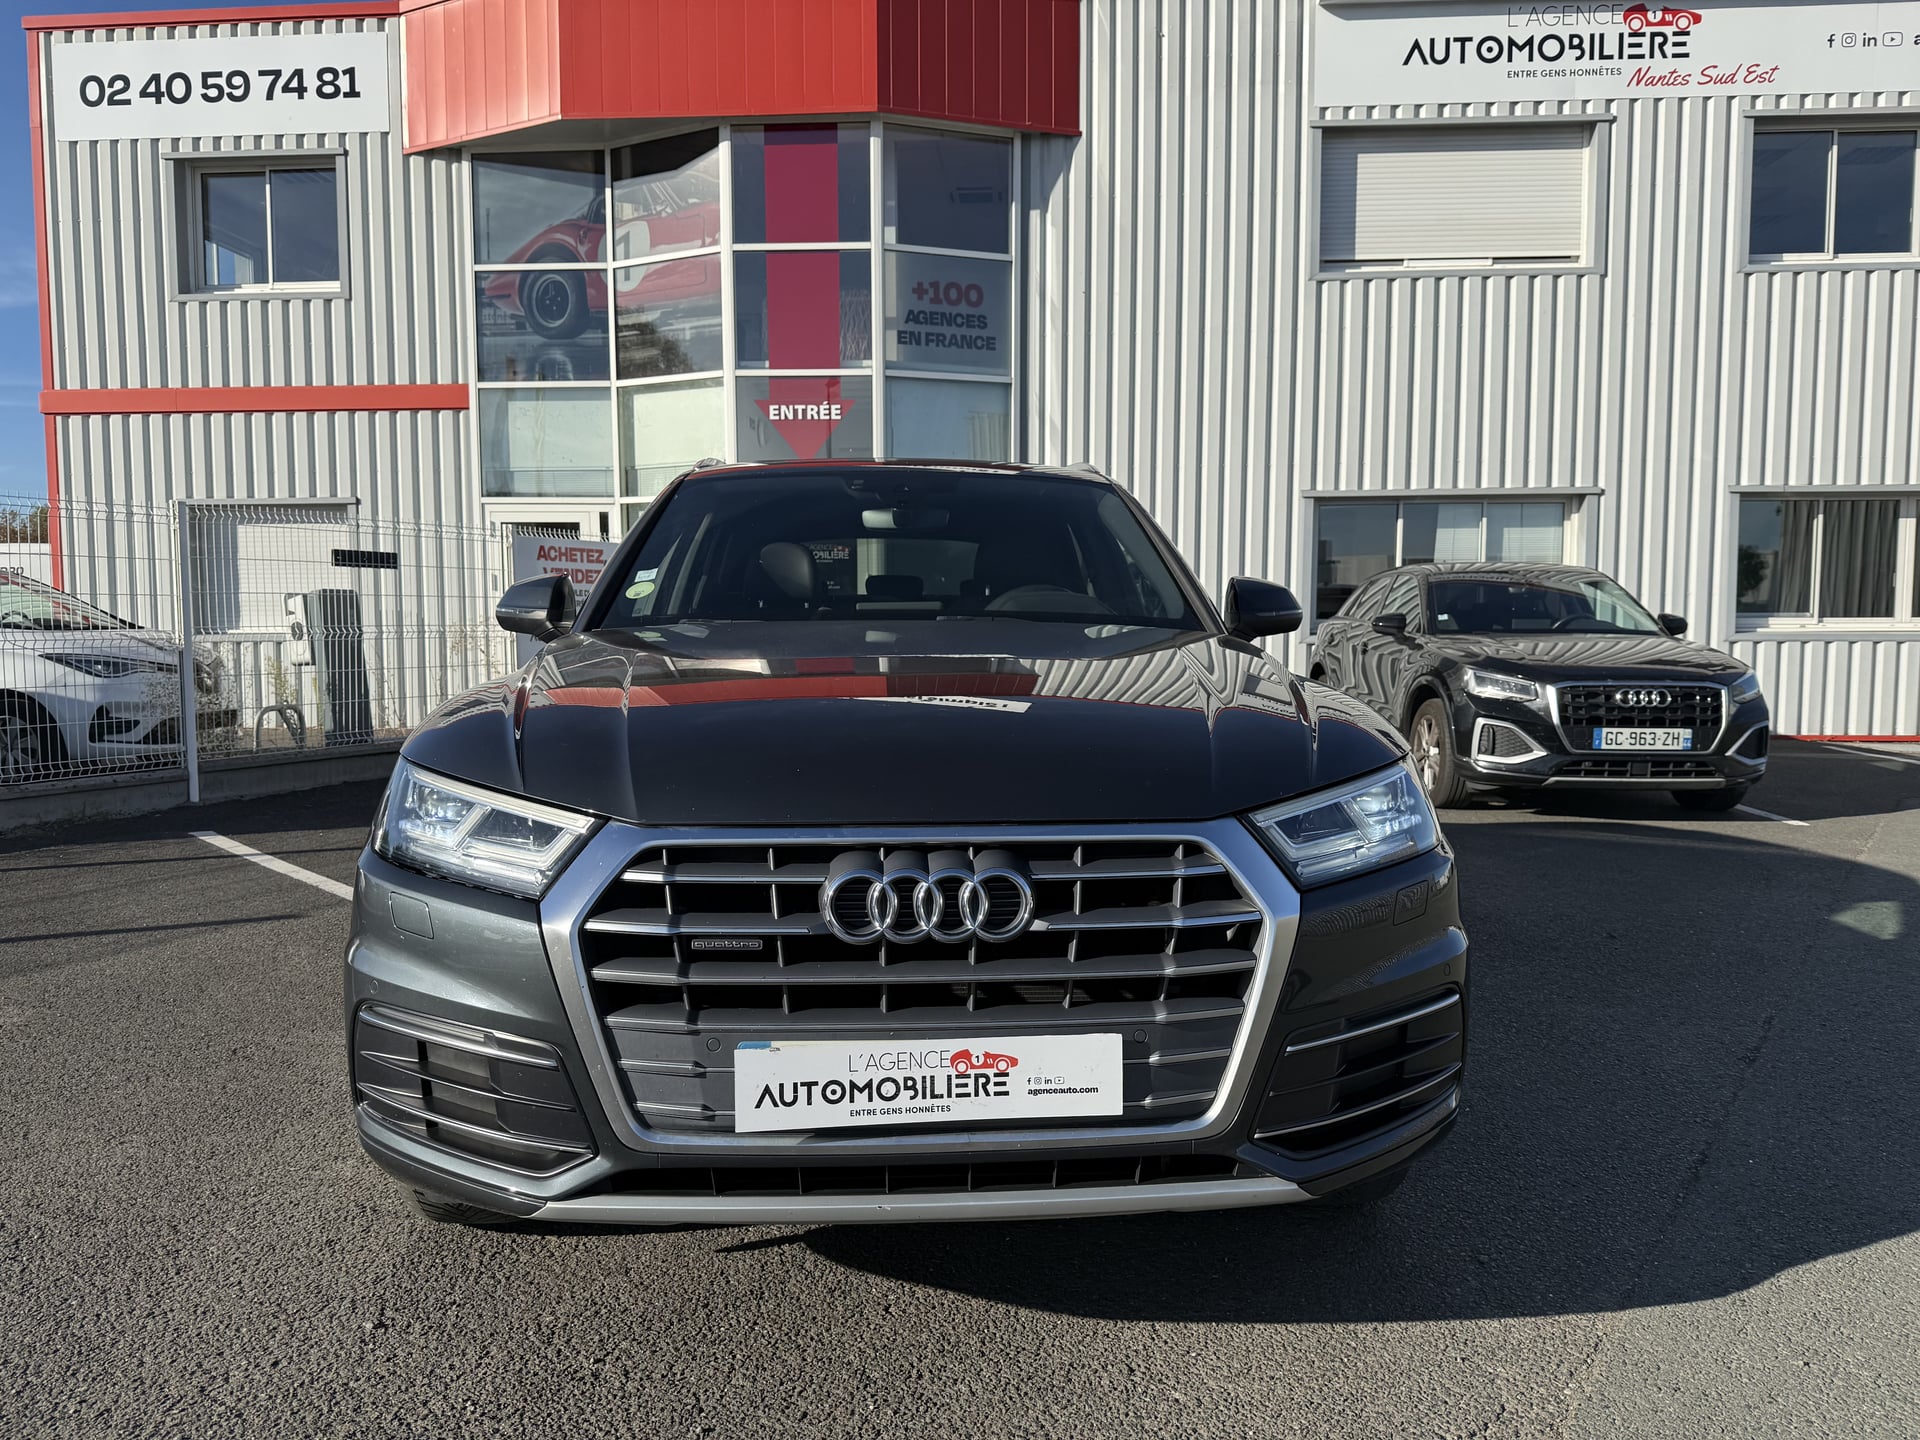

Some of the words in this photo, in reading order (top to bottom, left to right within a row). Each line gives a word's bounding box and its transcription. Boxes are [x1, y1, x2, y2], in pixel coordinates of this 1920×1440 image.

[1507, 4, 1623, 27] L'AGENCE
[1507, 70, 1538, 79] ENTRE
[1540, 69, 1567, 78] GENS
[1569, 65, 1622, 77] HONNÊTES
[1627, 66, 1691, 88] Nantes
[1697, 63, 1743, 85] Sud
[1743, 64, 1780, 84] Est
[79, 74, 132, 108] 02
[139, 72, 192, 105] 40
[200, 70, 251, 103] 59
[258, 68, 308, 101] 74
[315, 66, 361, 100] 81
[911, 281, 984, 308] +100
[904, 309, 988, 330] AGENCES
[896, 330, 922, 346] EN
[925, 331, 997, 352] FRANCE
[769, 401, 842, 420] ENTRÉE
[1605, 731, 1680, 747] GC-963-ZH
[694, 940, 760, 949] quattro
[849, 1050, 951, 1072] L'AGENCE
[1027, 1087, 1099, 1096] agenceauto.com
[850, 1109, 877, 1117] ENTRE
[879, 1107, 903, 1116] GENS
[905, 1104, 951, 1114] HONNÊTES
